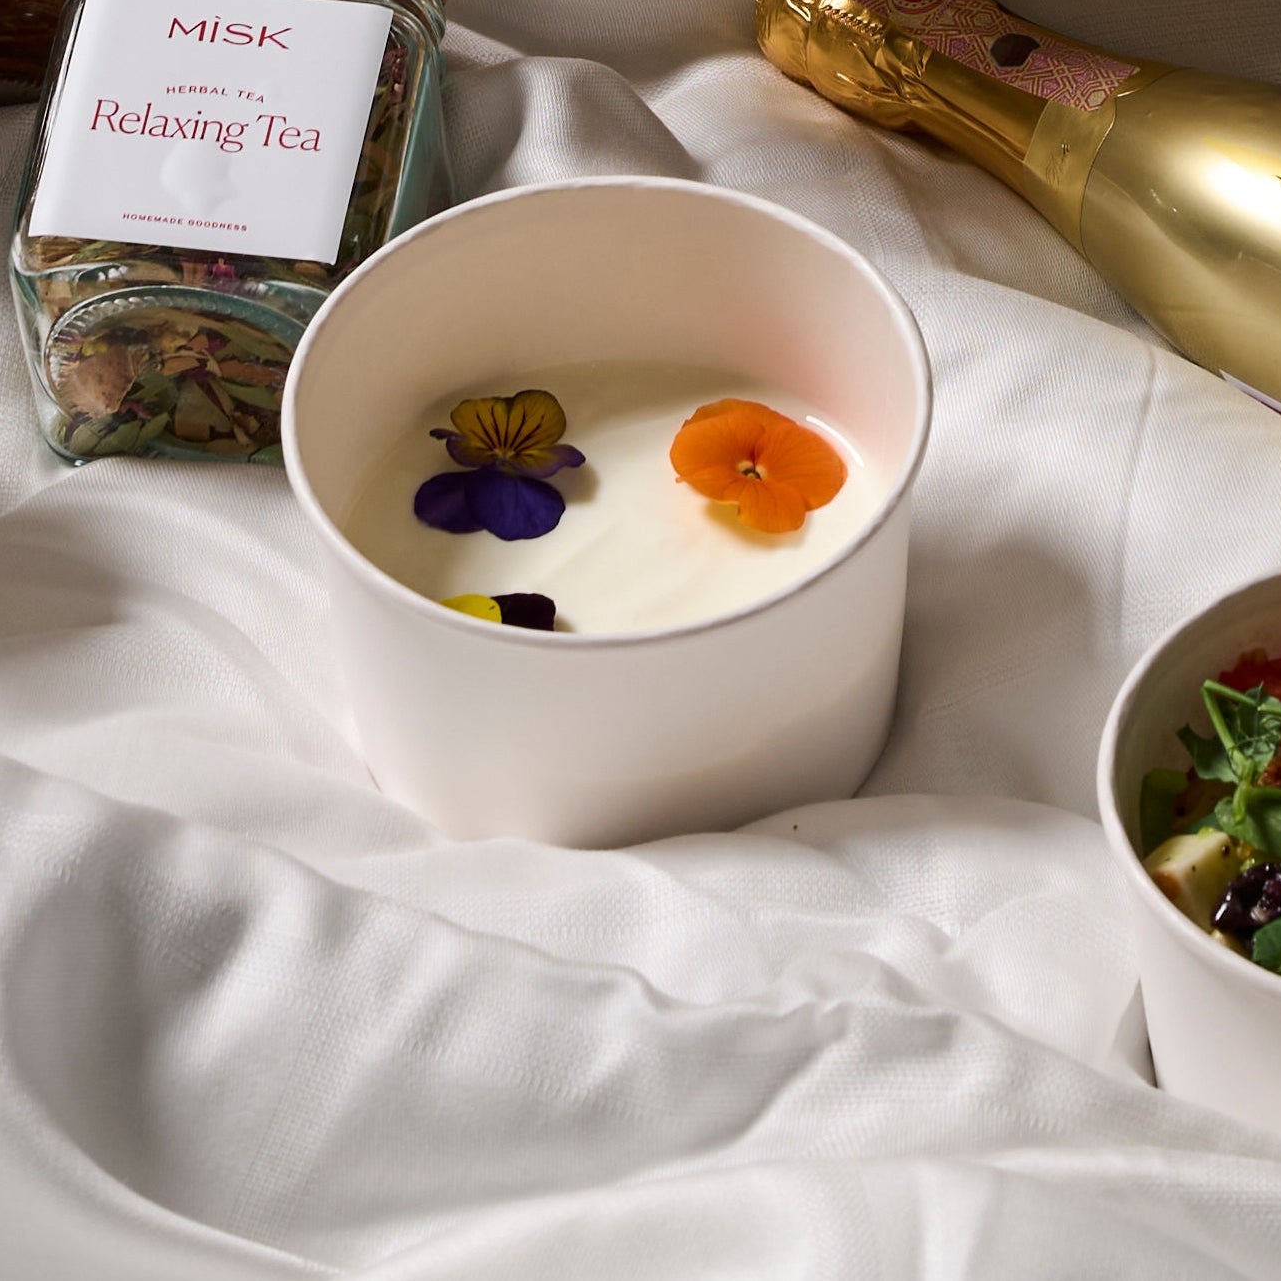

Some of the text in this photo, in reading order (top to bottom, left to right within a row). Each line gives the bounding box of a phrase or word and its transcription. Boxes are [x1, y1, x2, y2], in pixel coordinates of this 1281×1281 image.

[166, 85, 265, 103] HERBAL TEA
[90, 99, 322, 153] Relaxing Tea
[122, 213, 248, 232] HOMEMADE GOODNESS
